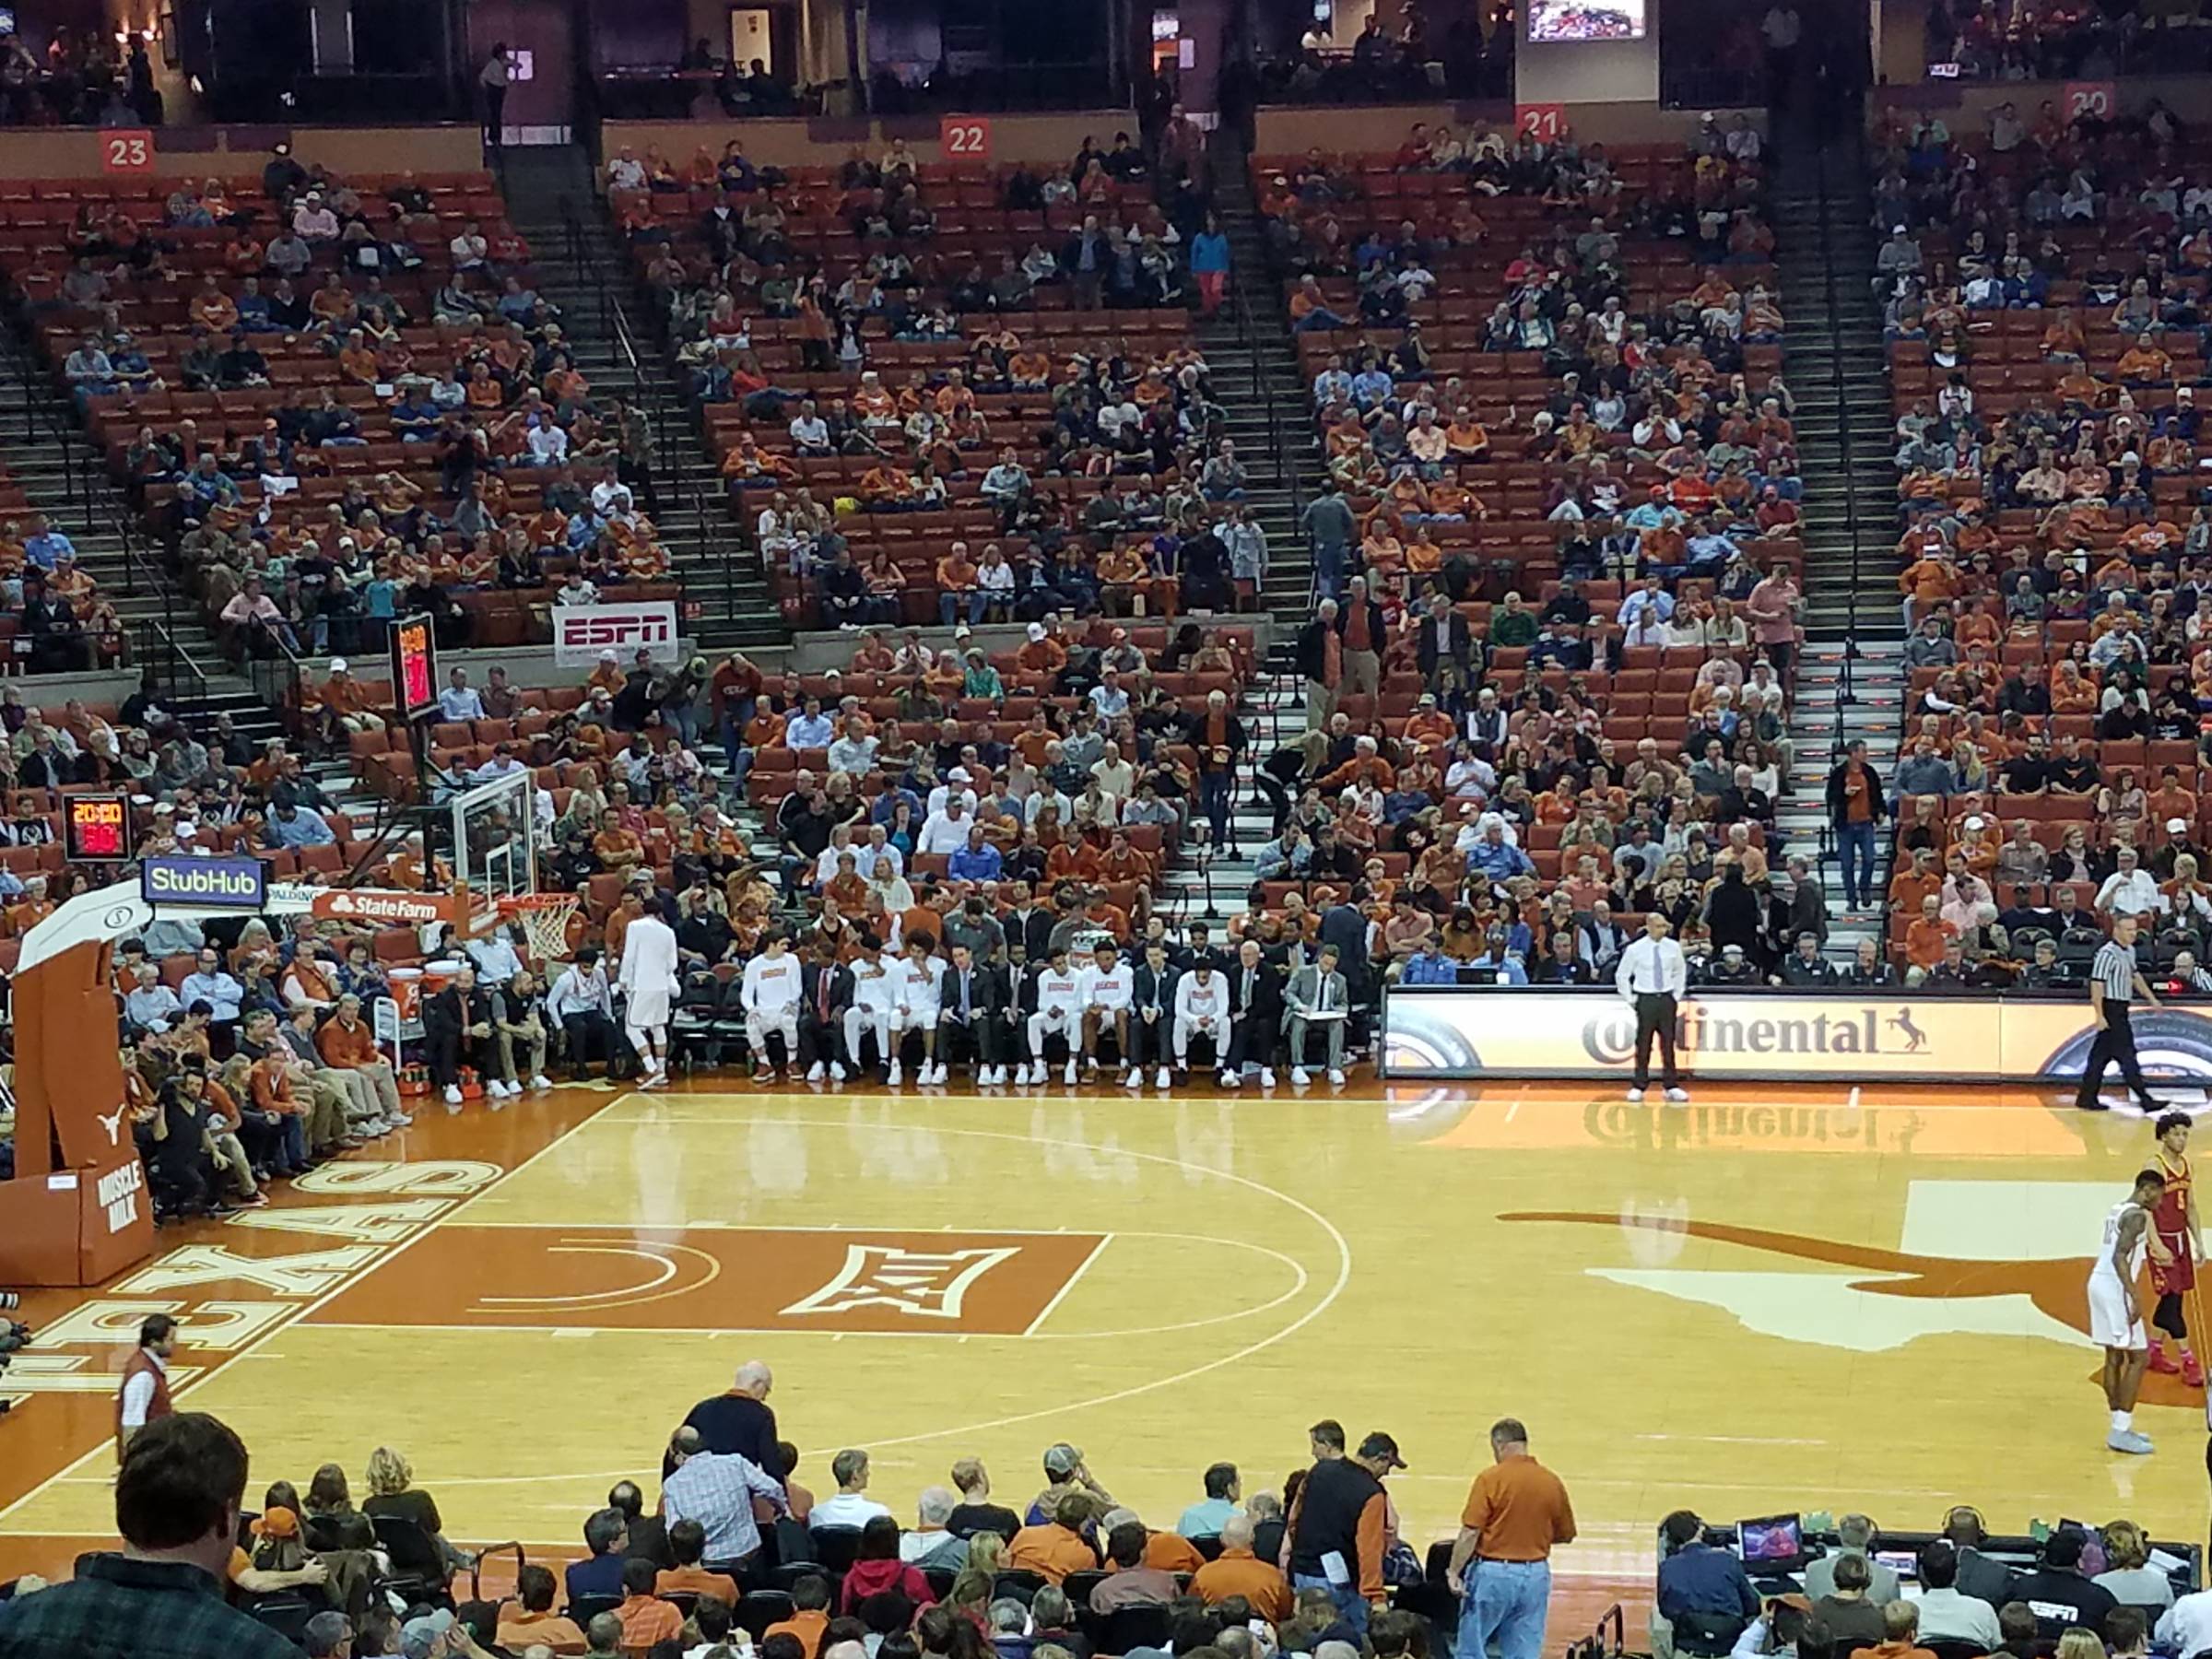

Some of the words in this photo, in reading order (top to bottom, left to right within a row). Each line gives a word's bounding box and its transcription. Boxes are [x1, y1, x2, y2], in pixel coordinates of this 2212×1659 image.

[1524, 111, 1557, 135] 21
[110, 139, 147, 165] 23
[949, 127, 983, 152] 22
[564, 616, 667, 645] ESPN
[151, 867, 257, 895] StubHub
[1583, 1006, 1880, 1065] Cotinental
[99, 1160, 142, 1207] MUSCLE
[109, 1194, 138, 1234] MILK
